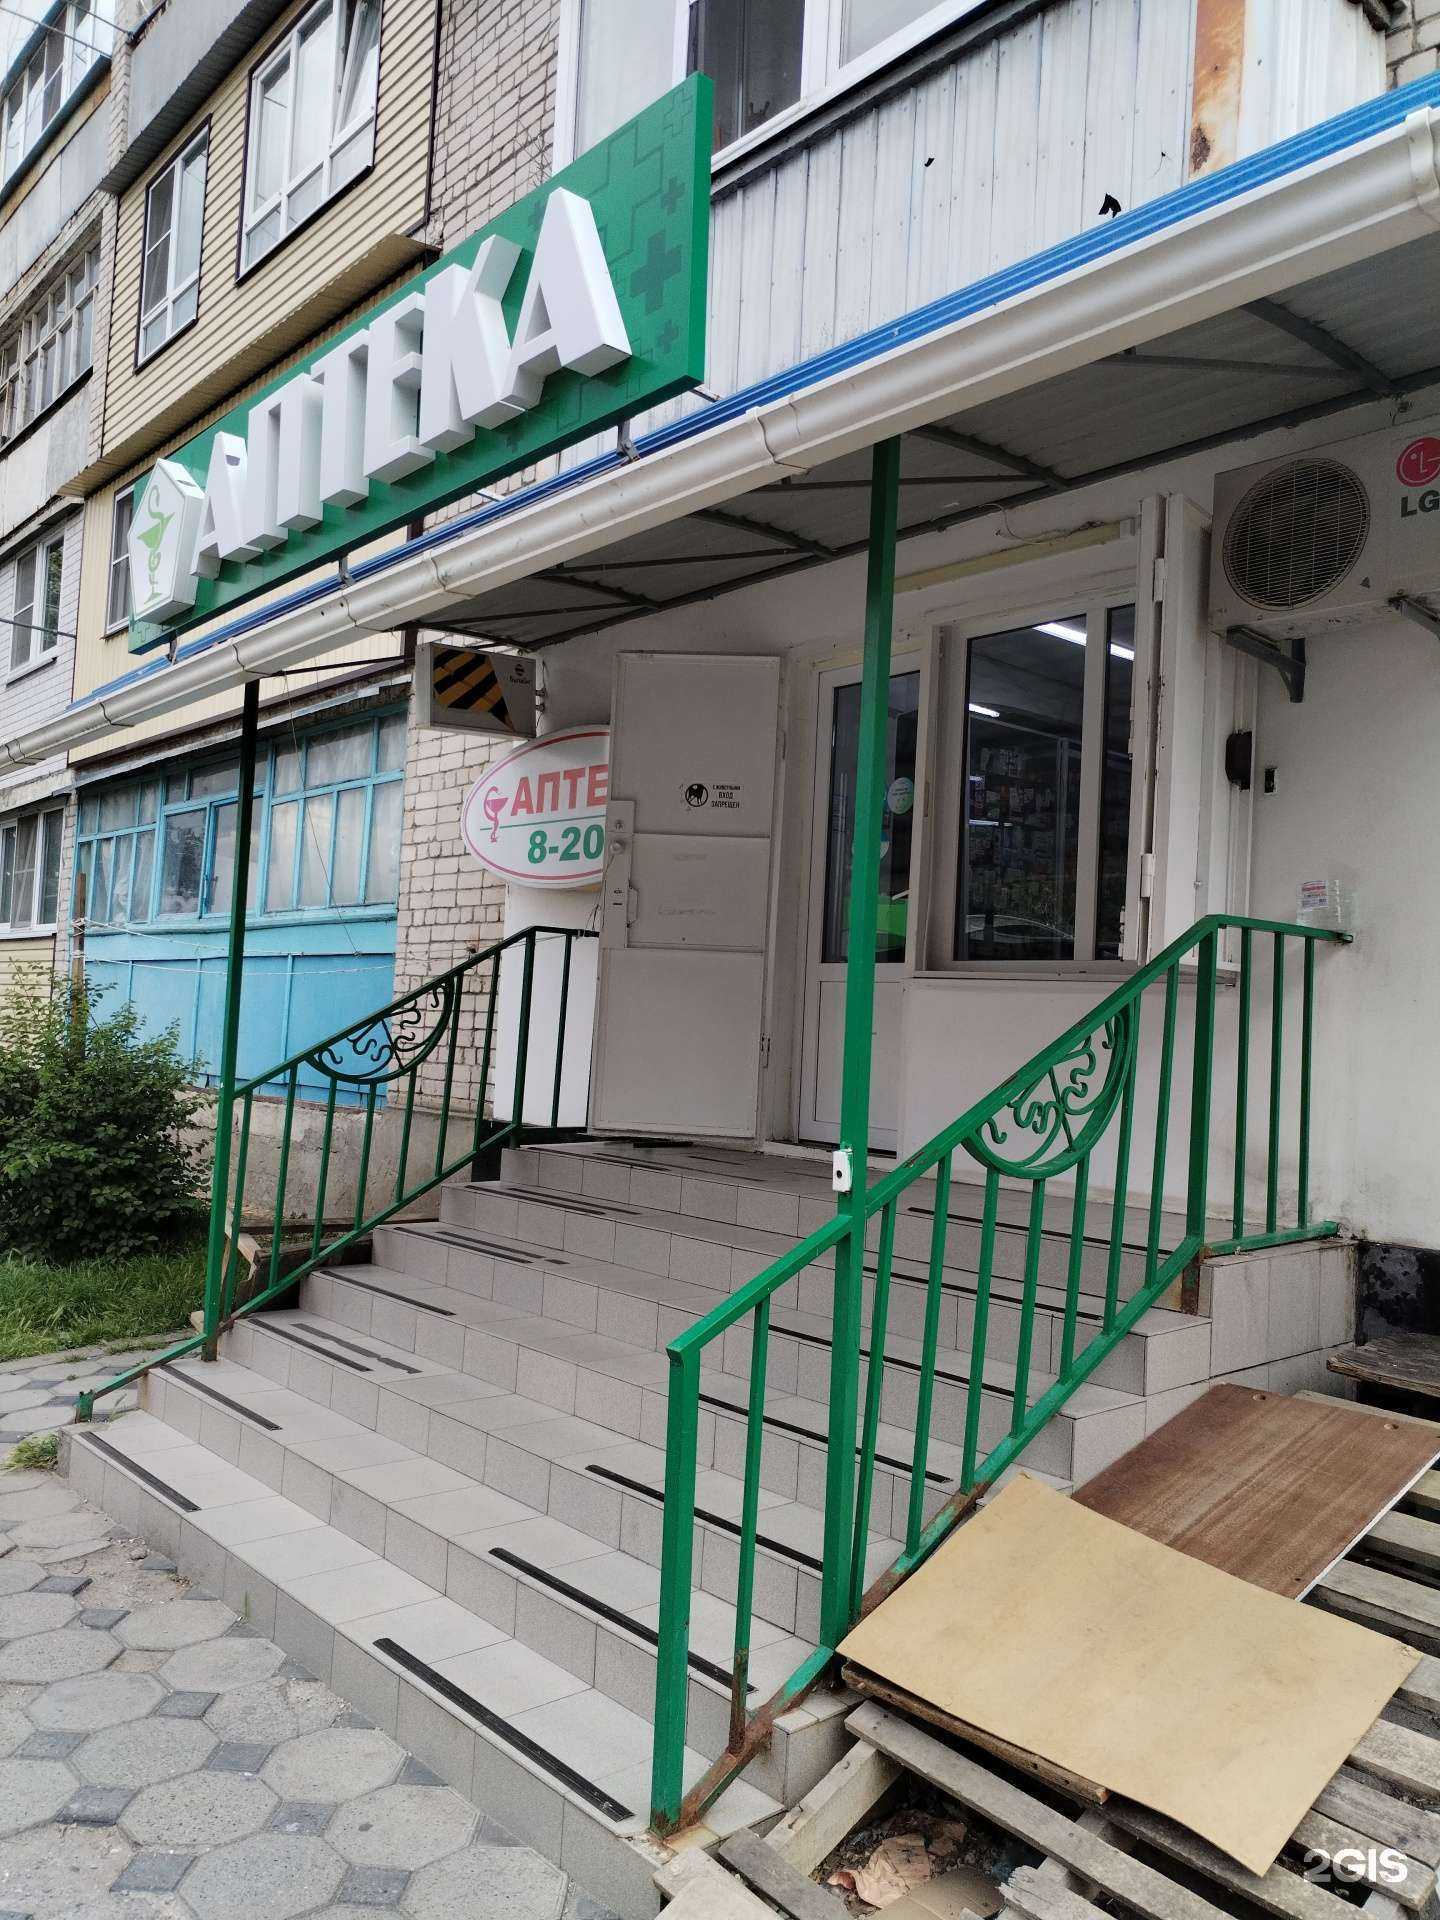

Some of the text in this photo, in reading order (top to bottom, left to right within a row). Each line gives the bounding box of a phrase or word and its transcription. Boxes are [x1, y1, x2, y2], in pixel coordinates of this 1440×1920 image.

[190, 187, 632, 580] АПТЕКА
[1401, 490, 1440, 518] LG
[510, 764, 609, 817] АПТЕ
[527, 824, 605, 865] 8-20
